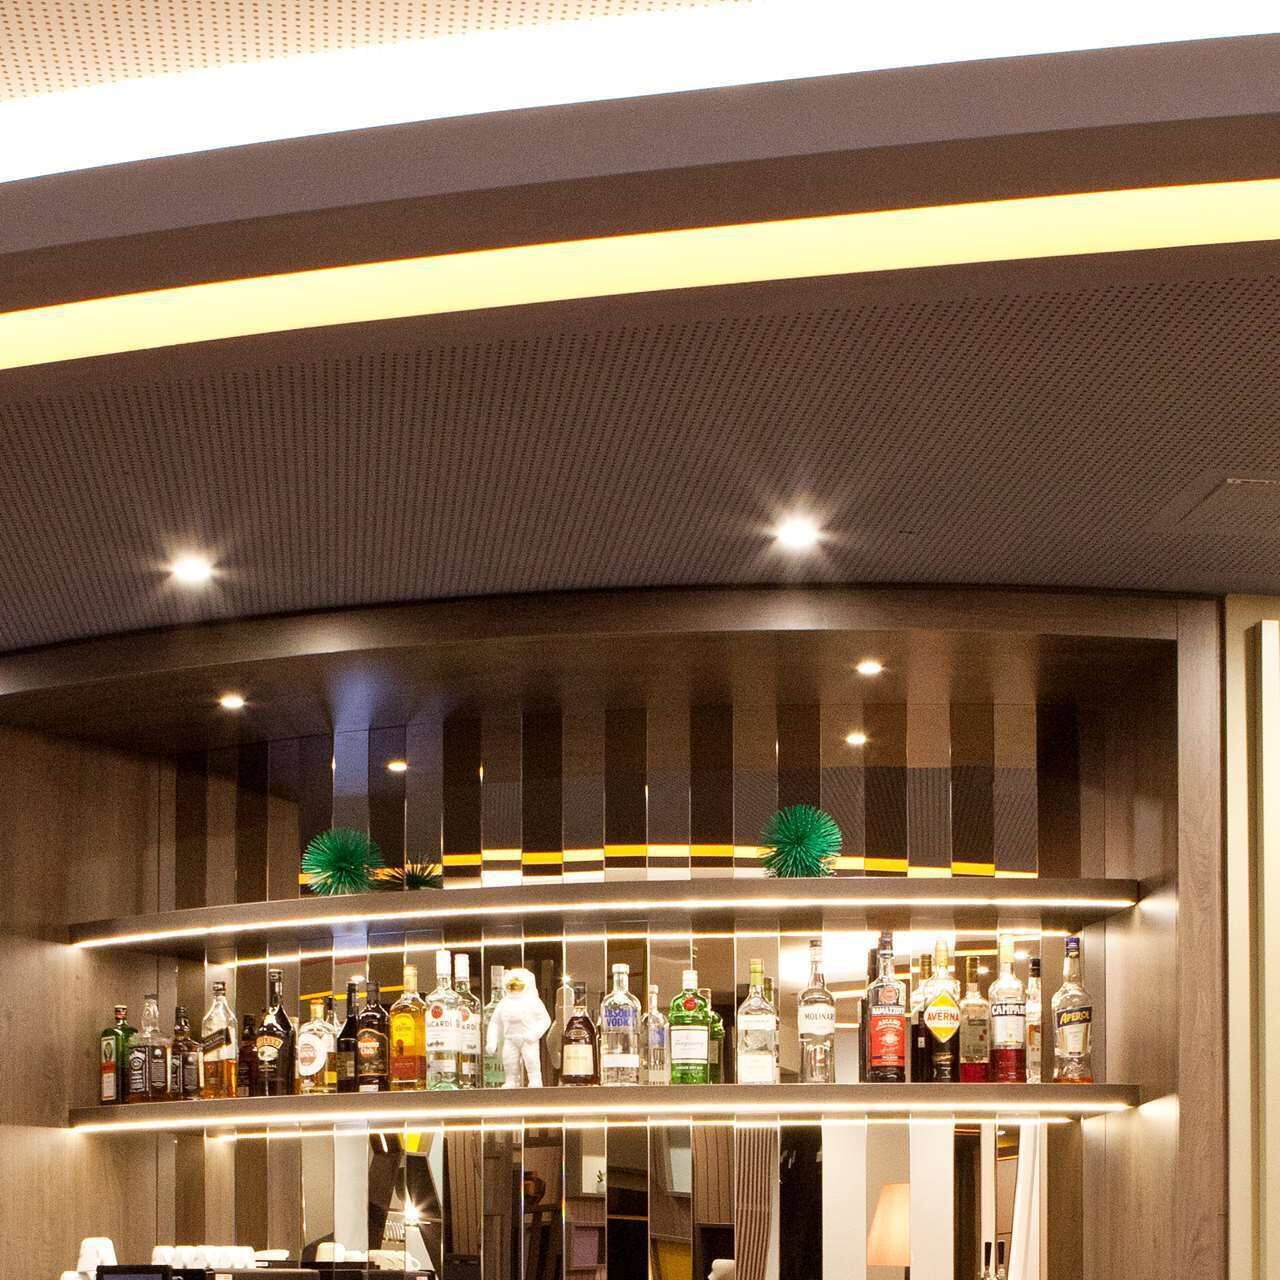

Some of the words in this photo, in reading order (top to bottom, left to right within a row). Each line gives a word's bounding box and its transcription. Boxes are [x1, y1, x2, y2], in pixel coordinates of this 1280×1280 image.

[804, 1013, 834, 1021] MOLINAR
[927, 1012, 960, 1021] AVERNA
[1060, 1011, 1090, 1025] APEROL
